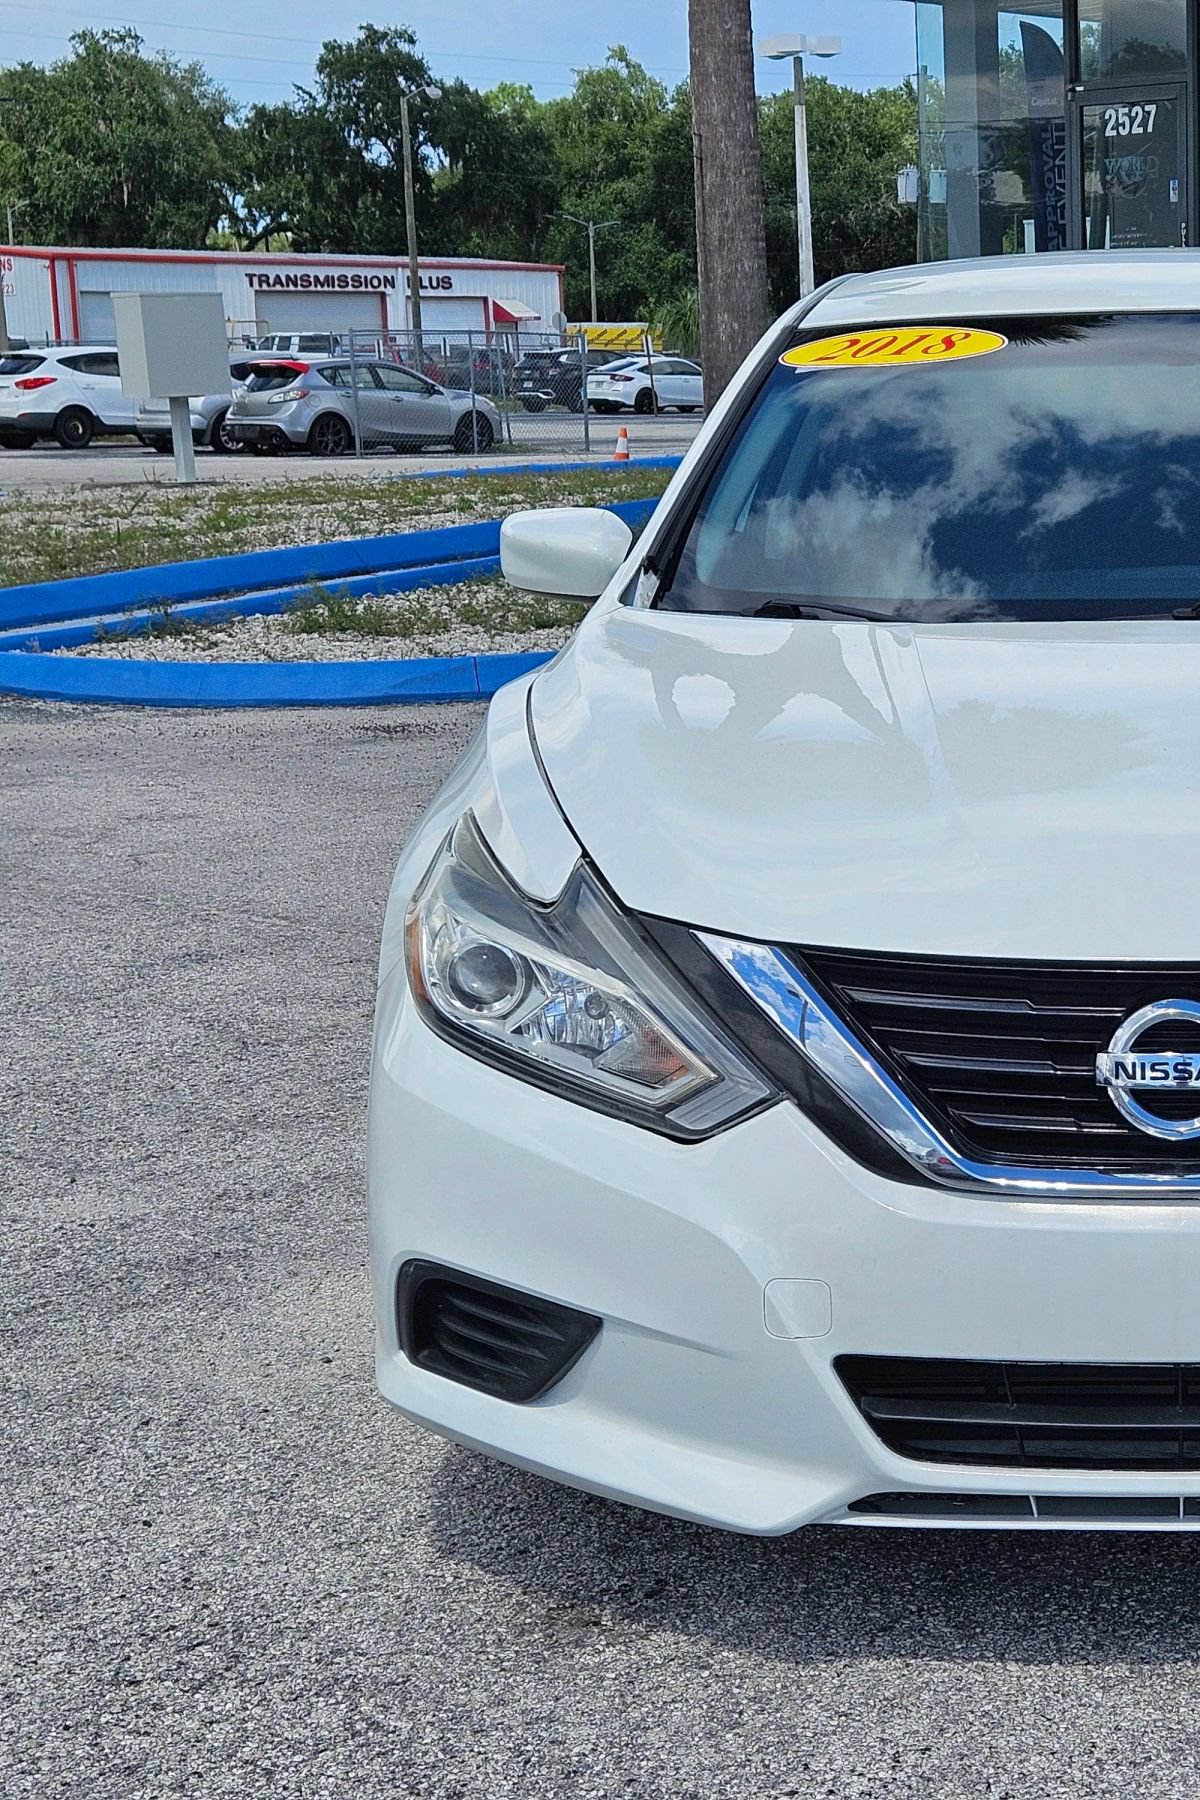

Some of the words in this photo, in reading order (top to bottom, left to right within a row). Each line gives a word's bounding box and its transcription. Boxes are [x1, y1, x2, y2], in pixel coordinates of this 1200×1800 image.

[1104, 104, 1157, 137] 2527
[245, 273, 396, 290] TRANSMISSION
[406, 276, 453, 290] LUS
[808, 332, 972, 363] 2018
